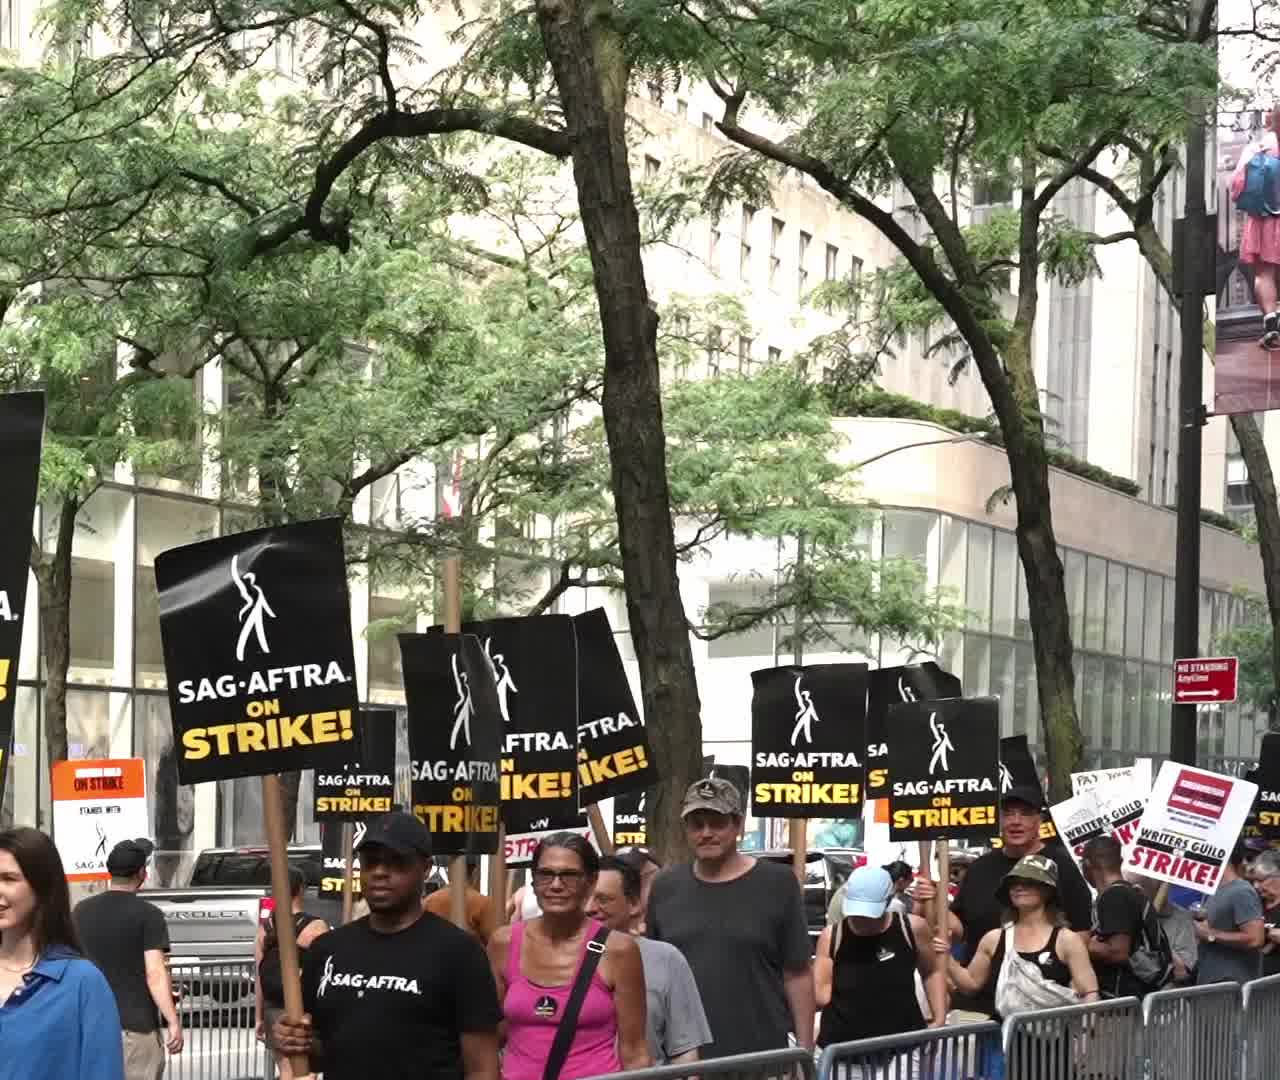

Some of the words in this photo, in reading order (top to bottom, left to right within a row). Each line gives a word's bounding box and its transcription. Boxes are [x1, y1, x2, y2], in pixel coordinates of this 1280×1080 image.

[246, 699, 280, 718] ON
[182, 709, 354, 760] STRIKE!
[501, 772, 572, 800] IKE!
[792, 771, 814, 782] ON
[317, 797, 391, 812] STRIKE!
[755, 783, 860, 804] STRIKE!
[932, 797, 952, 807] ON
[893, 806, 997, 829] STRIKE!
[1064, 815, 1110, 840] WRITERS
[1111, 799, 1142, 820] GUILD
[1141, 828, 1188, 849] WRITERS
[1191, 842, 1226, 859] GUILD
[1129, 847, 1221, 887] STRIKE!
